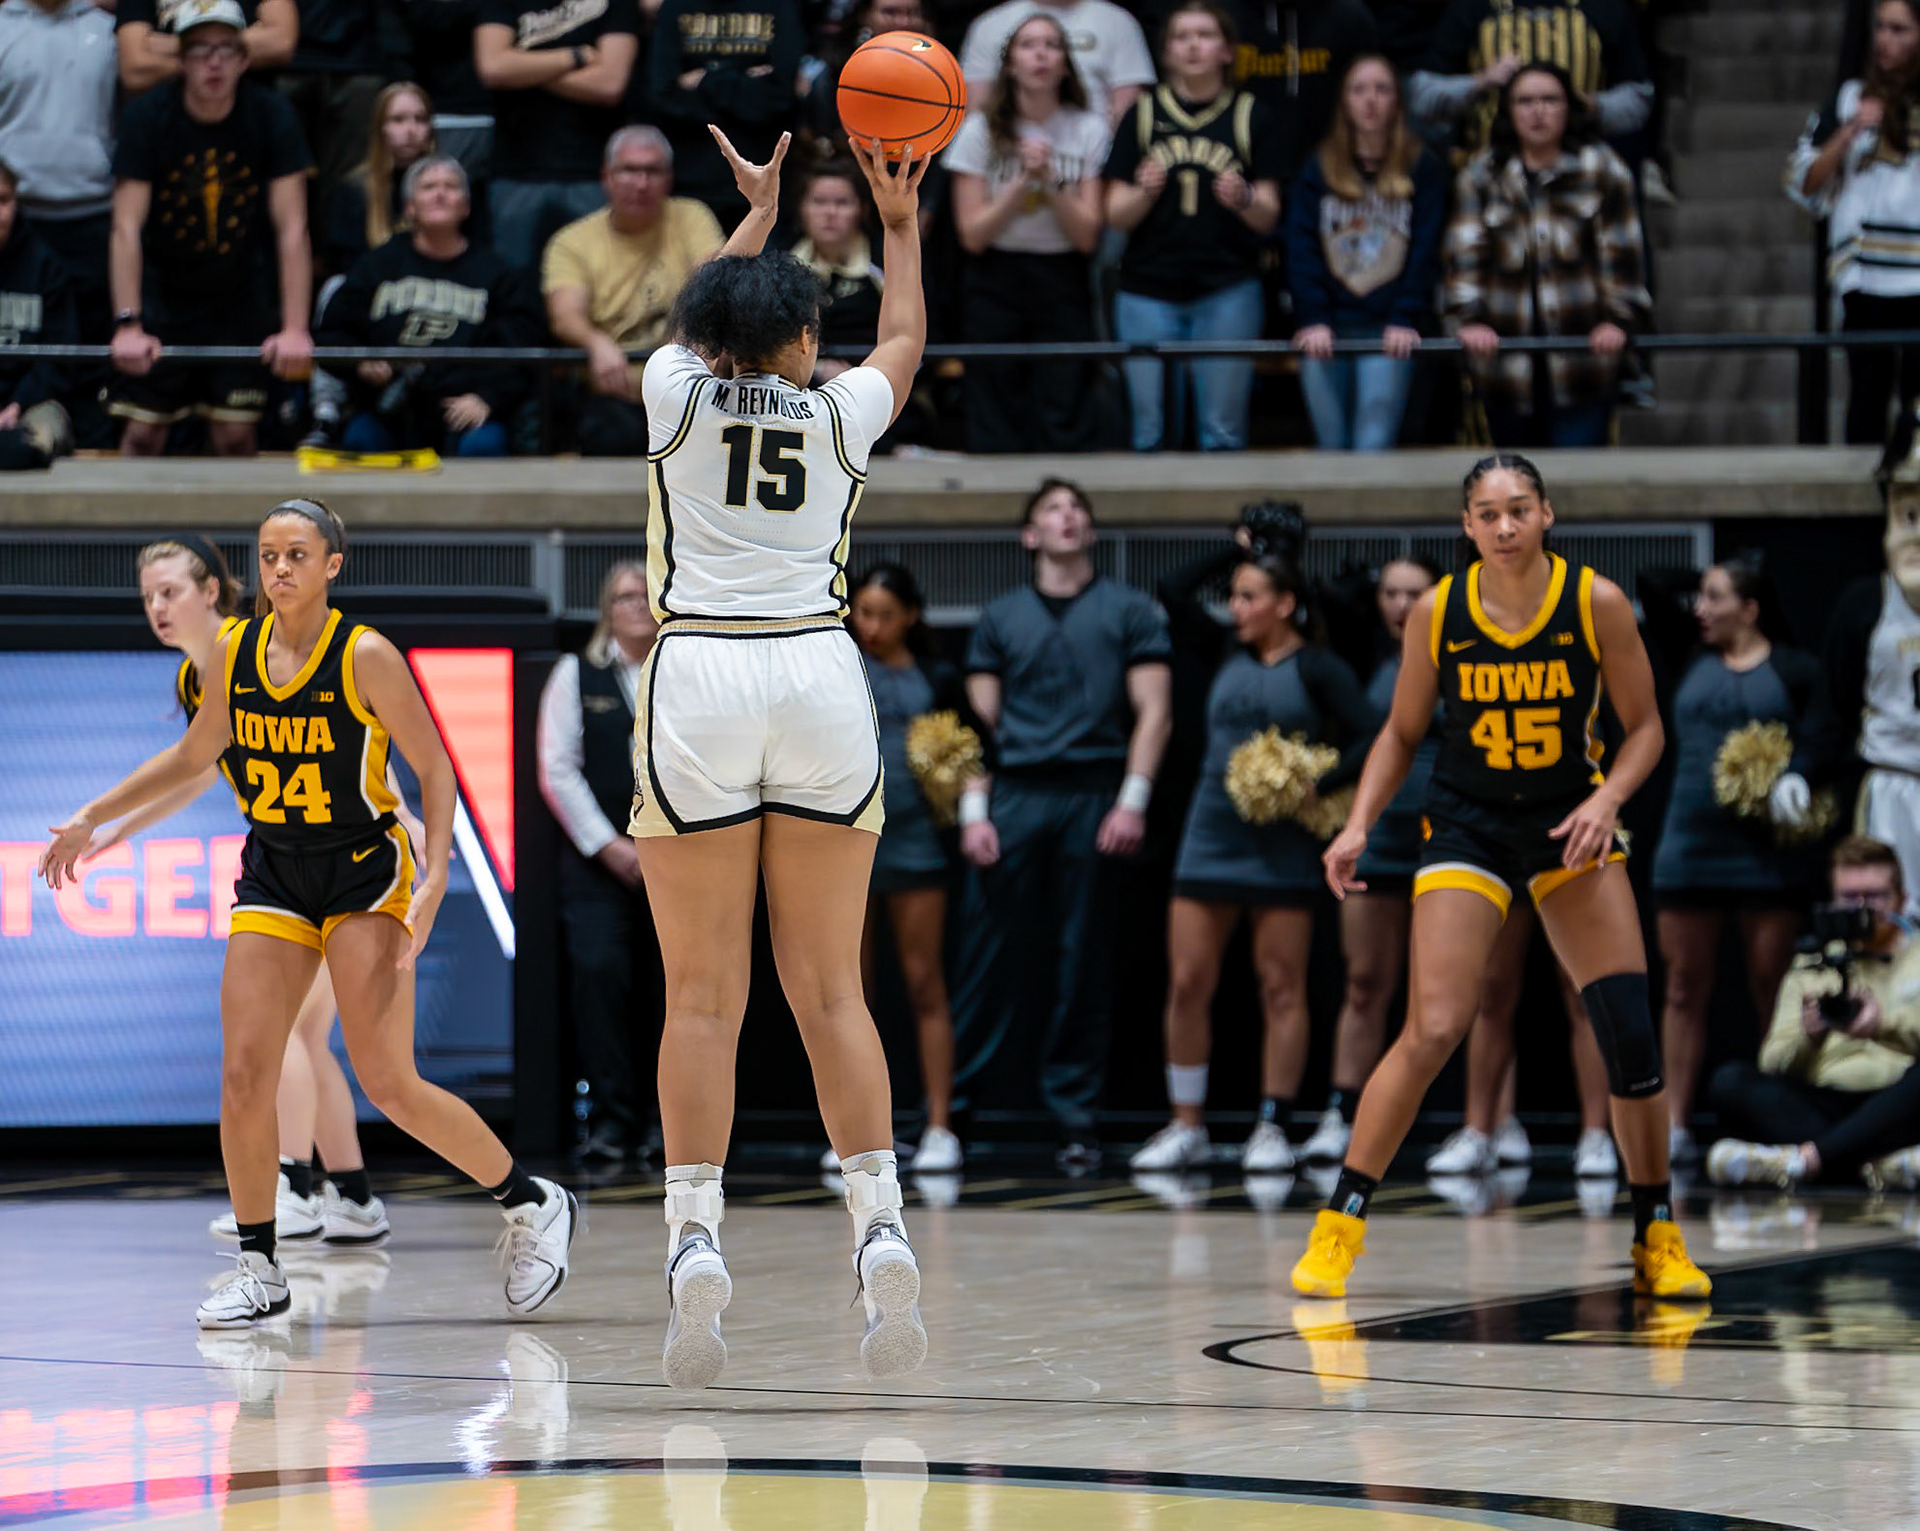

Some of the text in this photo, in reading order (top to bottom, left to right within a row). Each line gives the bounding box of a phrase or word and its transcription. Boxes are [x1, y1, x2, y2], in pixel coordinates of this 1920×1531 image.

[711, 382, 815, 420] M. REYNOLDS
[720, 422, 807, 514] 15
[1457, 659, 1575, 702] IOWA
[235, 707, 335, 754] IOWA
[1469, 706, 1562, 770] 45
[245, 757, 332, 824] 24
